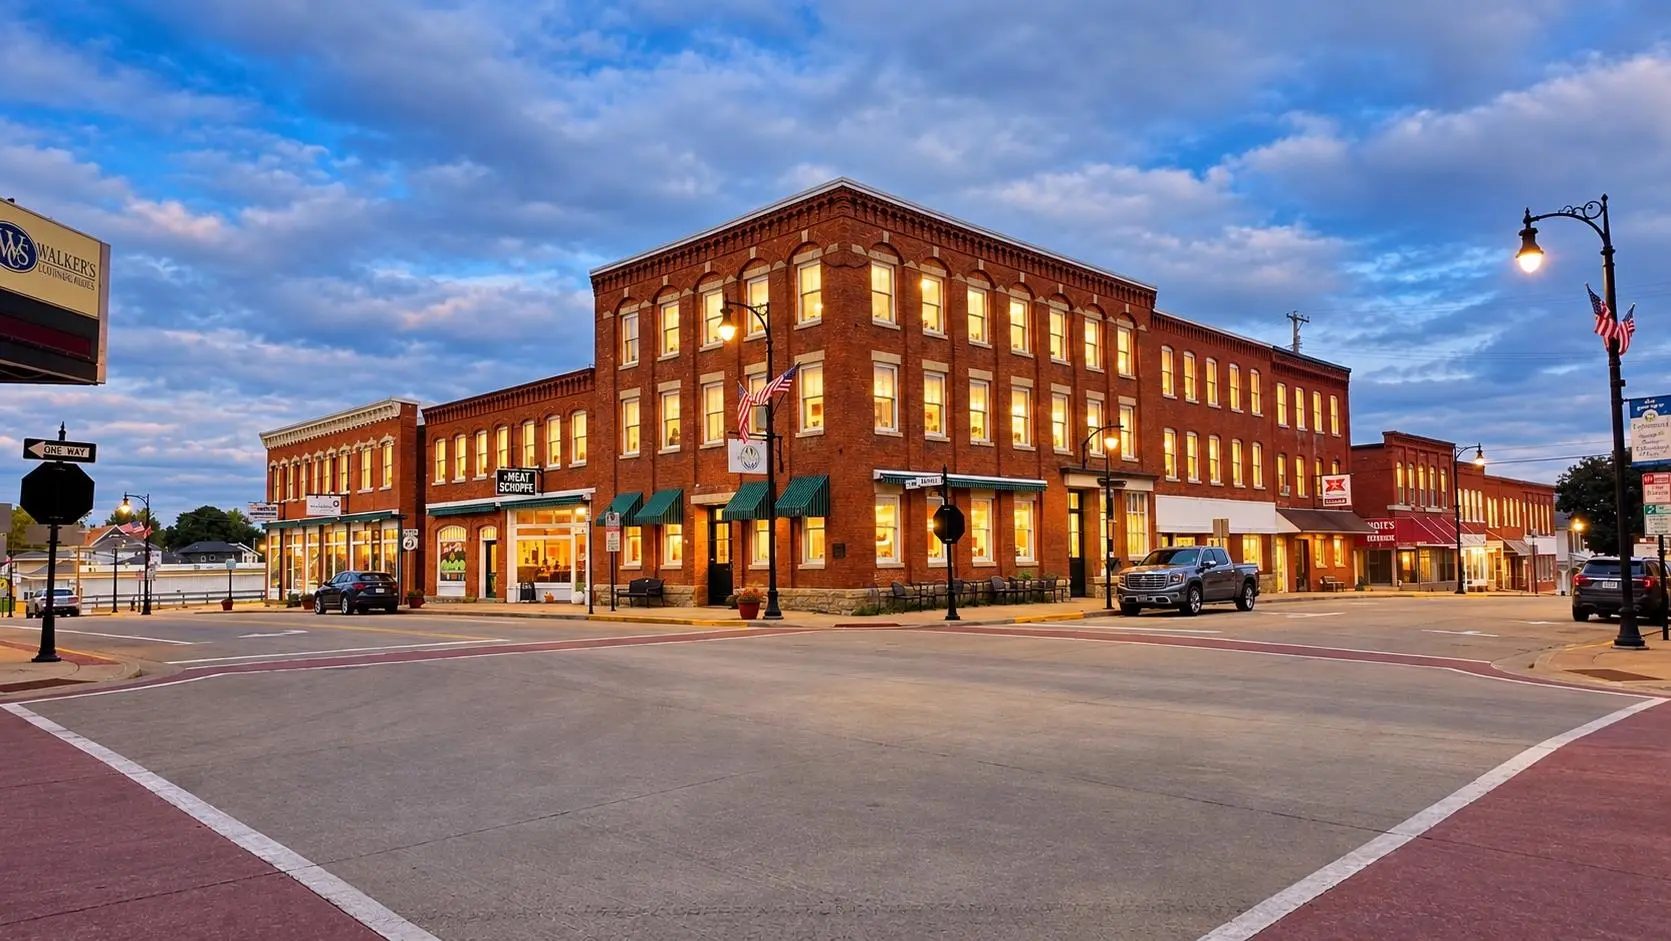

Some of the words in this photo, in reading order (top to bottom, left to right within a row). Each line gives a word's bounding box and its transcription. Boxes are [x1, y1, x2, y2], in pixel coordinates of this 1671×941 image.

[37, 242, 96, 278] WALKER'S
[43, 445, 62, 455] ONE
[67, 447, 85, 456] WAY
[507, 472, 530, 482] MEAT
